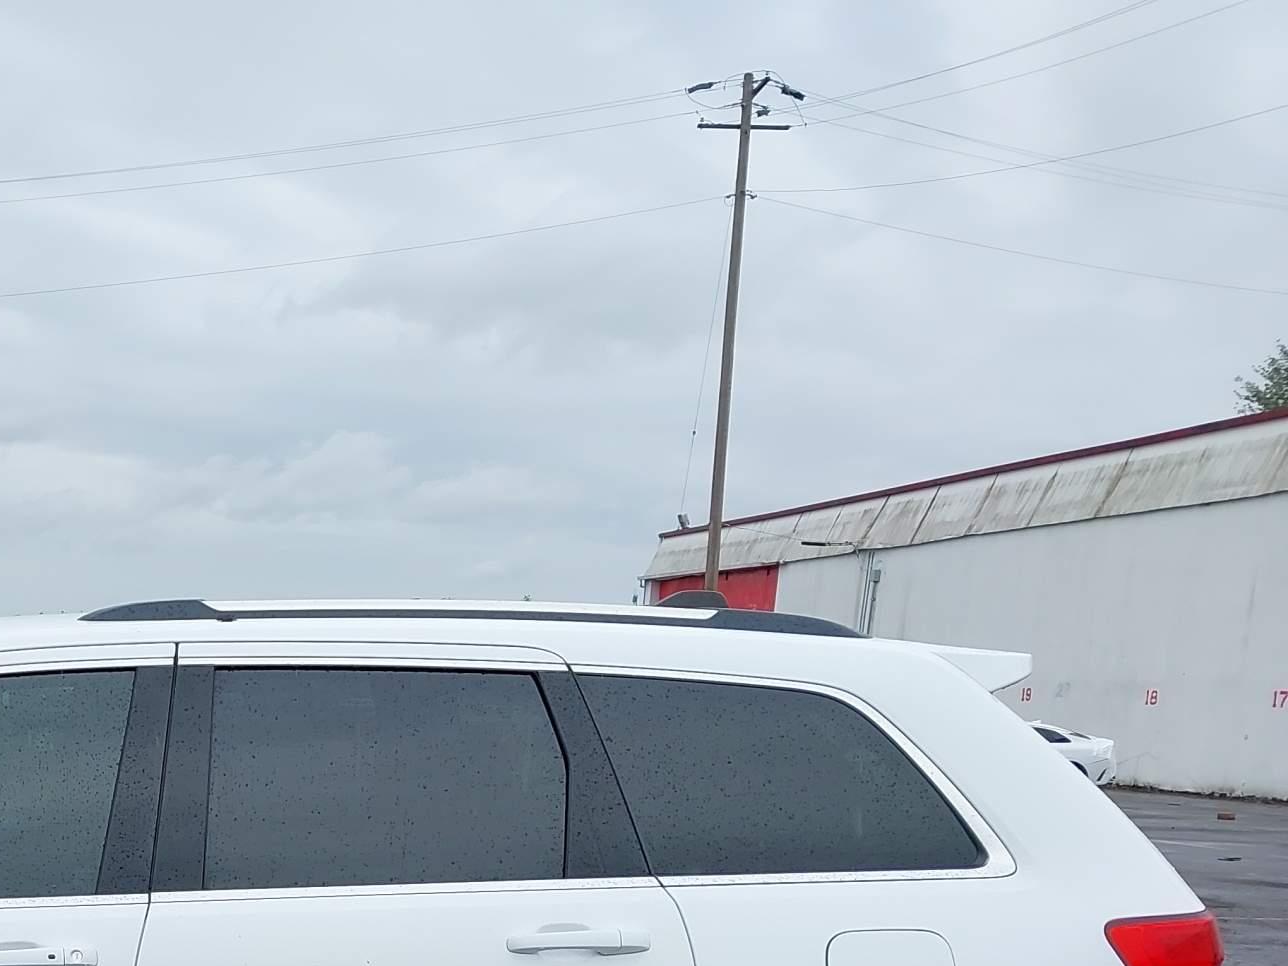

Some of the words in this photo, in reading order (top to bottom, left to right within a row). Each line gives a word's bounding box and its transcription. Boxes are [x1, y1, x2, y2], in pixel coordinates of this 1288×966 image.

[1021, 687, 1032, 702] 19
[1144, 689, 1158, 706] 18
[1272, 690, 1288, 708] 17
